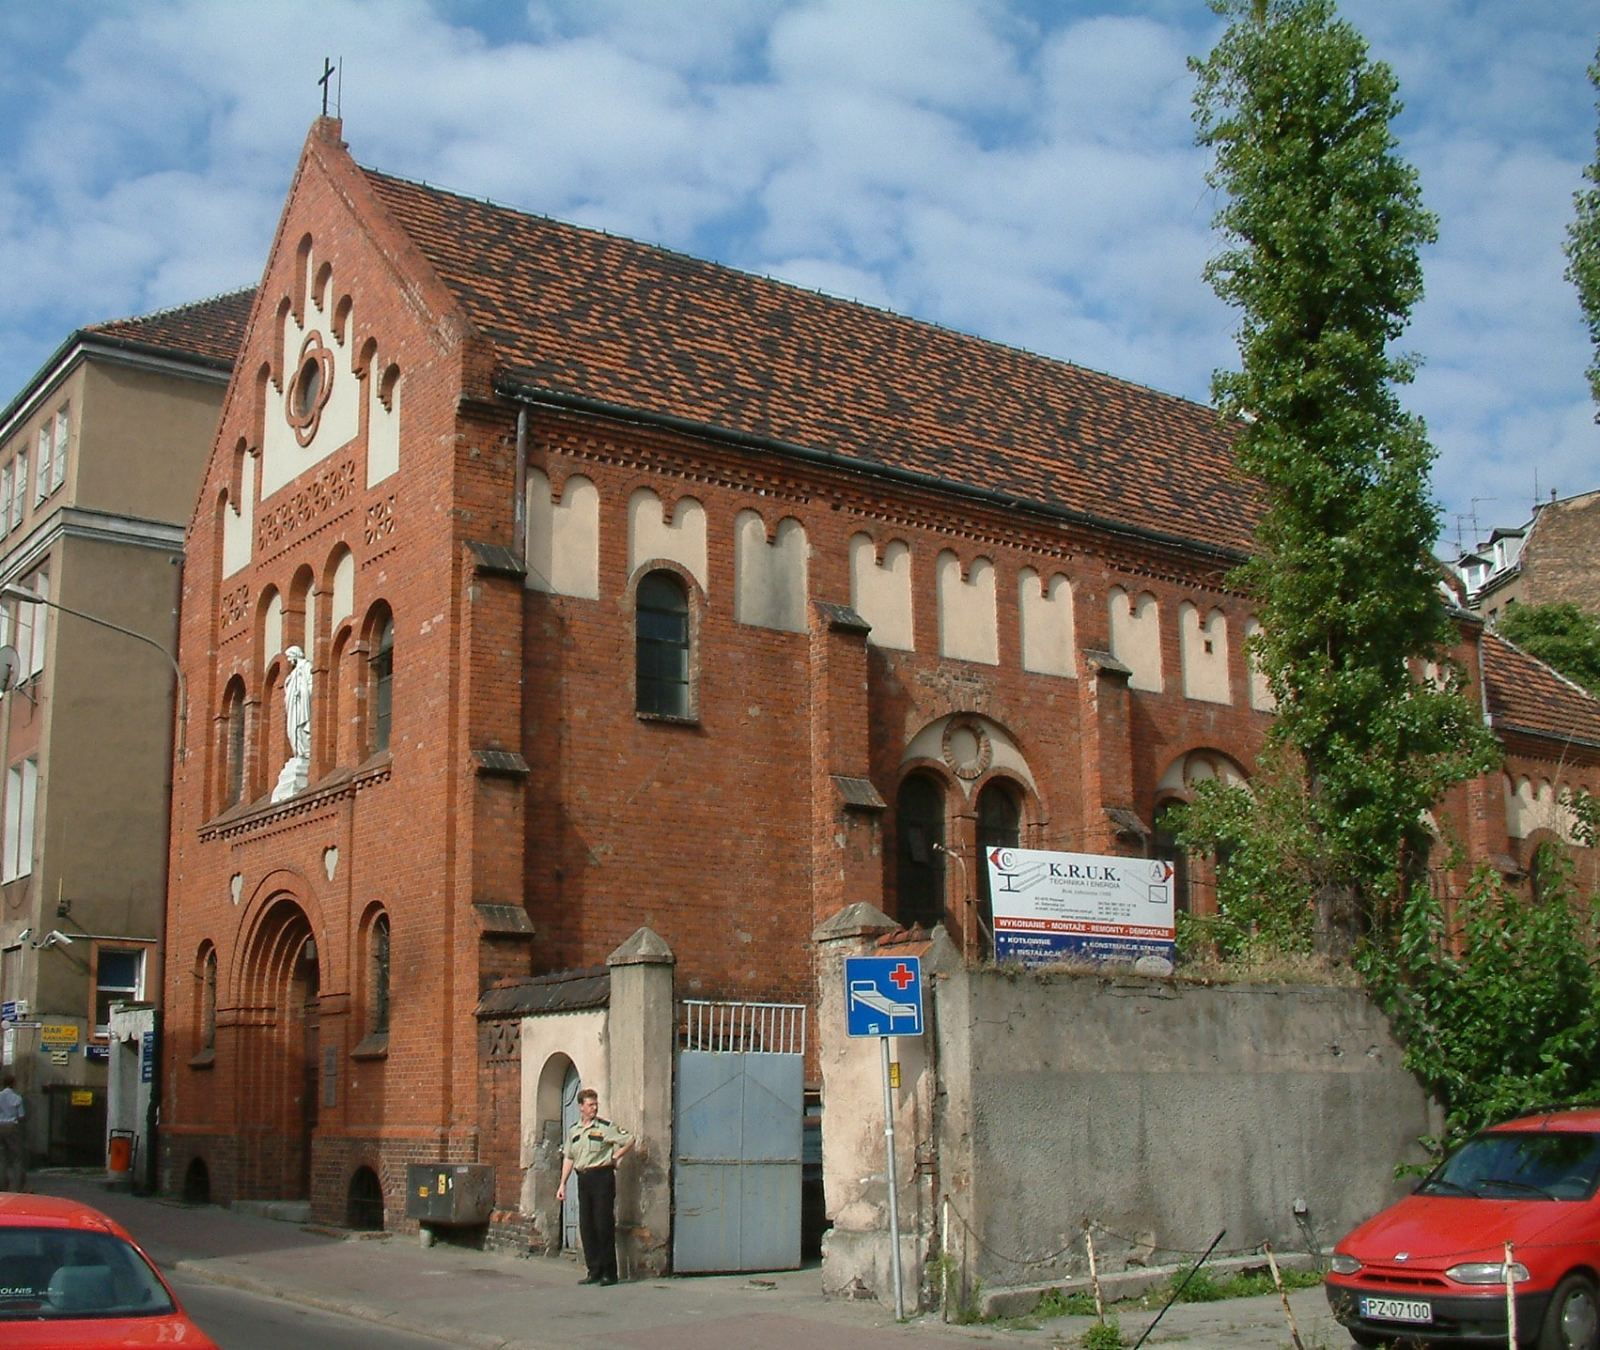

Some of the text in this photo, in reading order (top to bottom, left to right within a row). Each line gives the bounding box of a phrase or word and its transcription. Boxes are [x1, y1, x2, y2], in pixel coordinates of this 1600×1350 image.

[1049, 863, 1121, 882] K.R.U.K.
[1050, 877, 1086, 887] TECHNIKA
[1090, 880, 1121, 889] ENERGIA
[999, 919, 1170, 937] WYKONANIE MONTAŻE REMONTY DEMONTAŻE
[1089, 942, 1170, 953] KONSTRUKCJE STALOWE
[1368, 1300, 1429, 1318] PZ 07100
